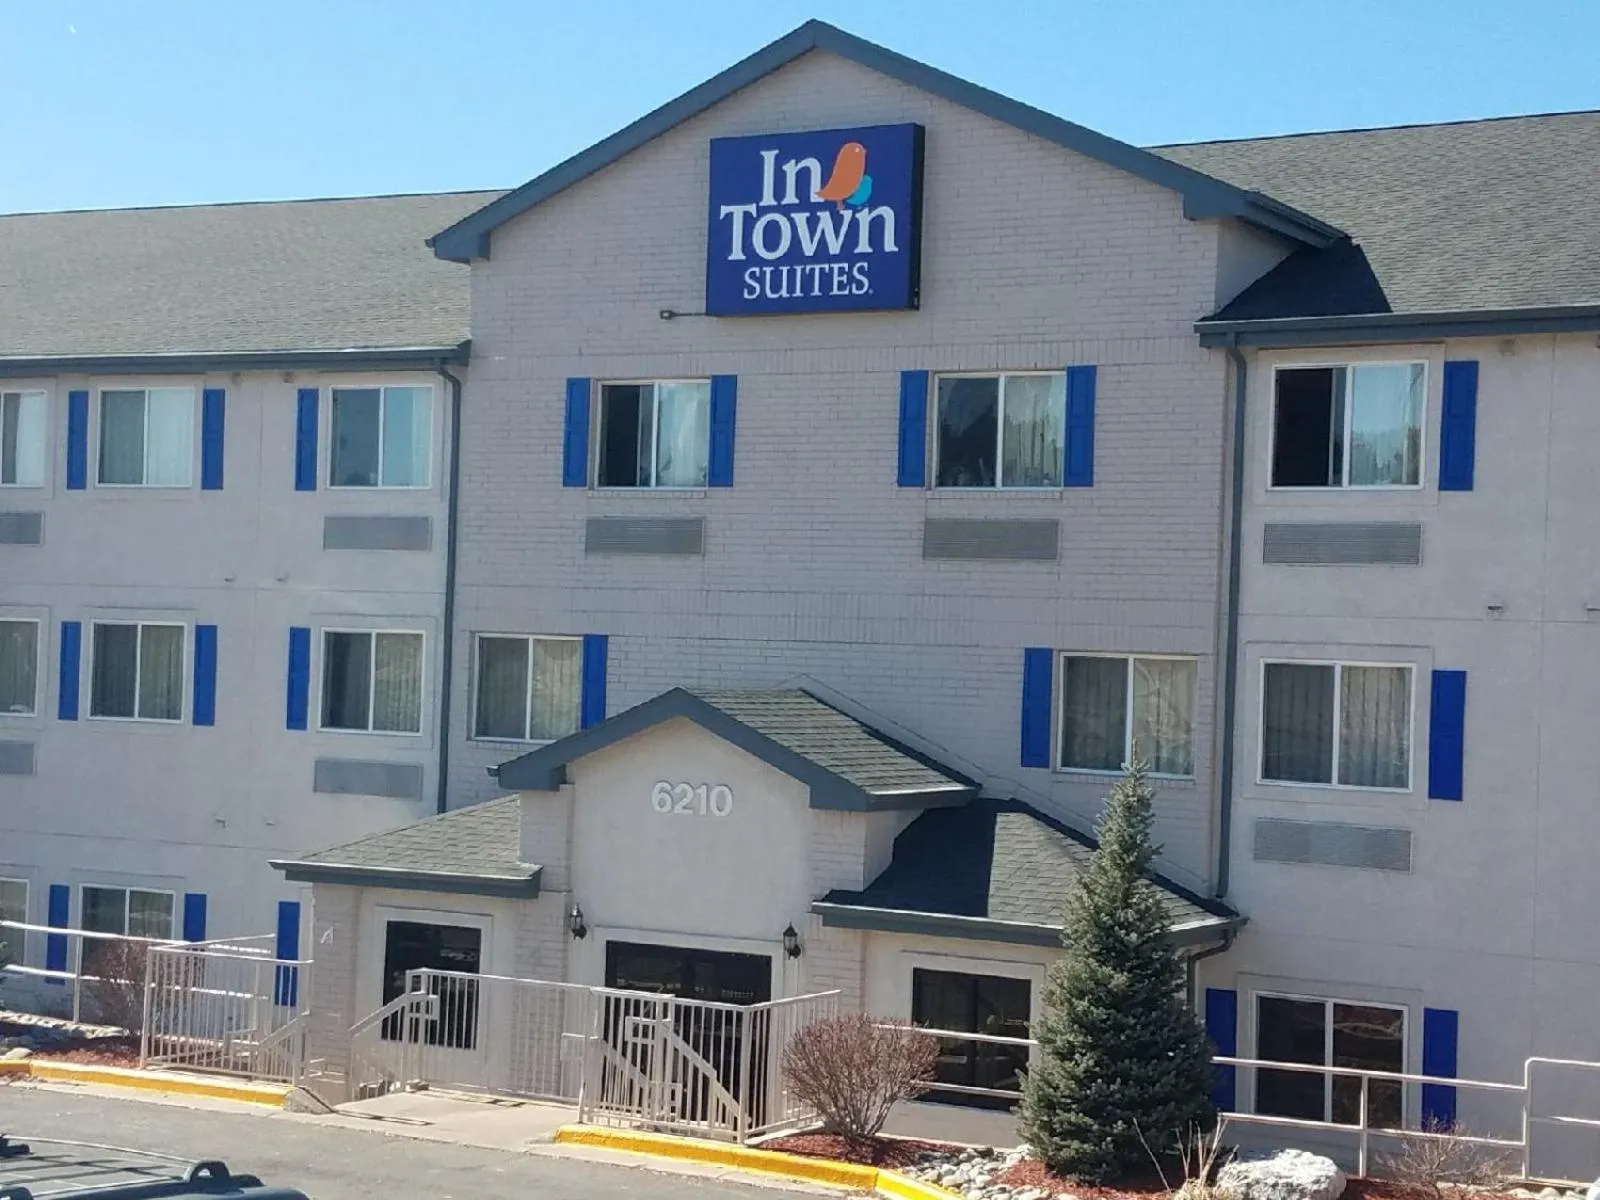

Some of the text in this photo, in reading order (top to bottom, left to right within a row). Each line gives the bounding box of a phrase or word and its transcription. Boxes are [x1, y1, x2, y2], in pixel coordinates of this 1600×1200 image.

[759, 149, 825, 206] In
[719, 203, 899, 261] Town
[743, 262, 870, 300] SUITES
[651, 780, 734, 817] 6210
